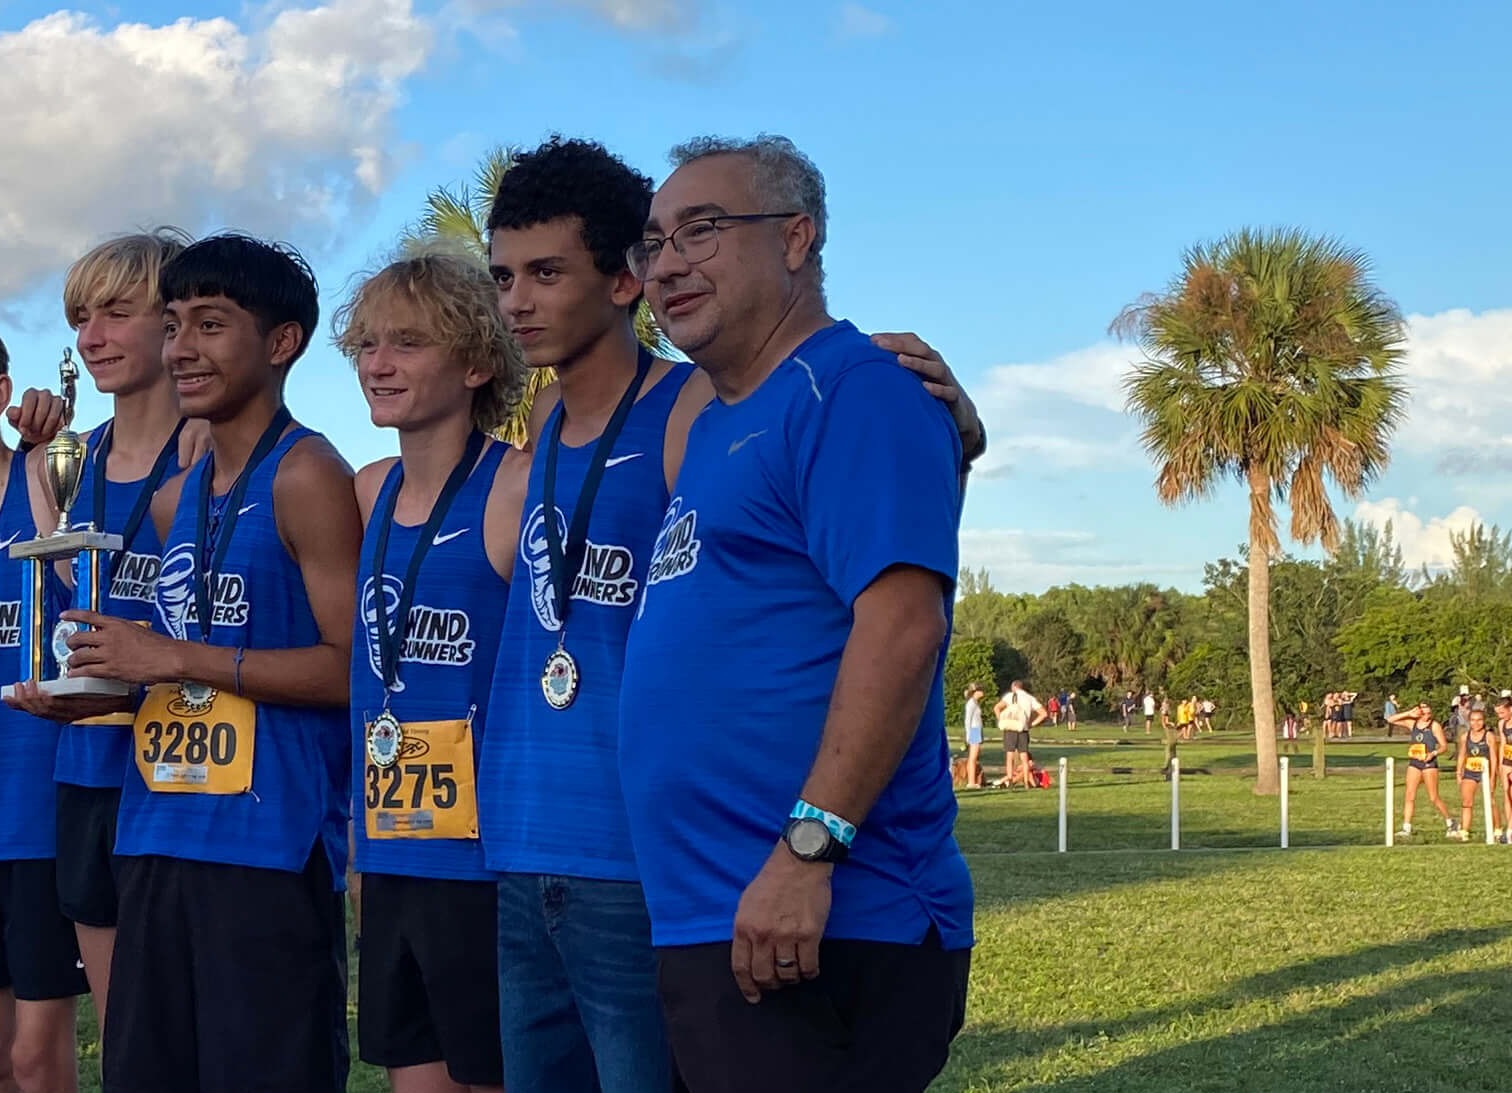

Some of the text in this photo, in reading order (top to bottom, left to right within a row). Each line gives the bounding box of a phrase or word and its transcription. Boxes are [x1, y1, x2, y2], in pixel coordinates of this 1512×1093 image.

[571, 576, 636, 603] UNNERS
[399, 639, 472, 663] RUNNERS
[143, 721, 237, 766] 3280
[366, 764, 458, 810] 3275
